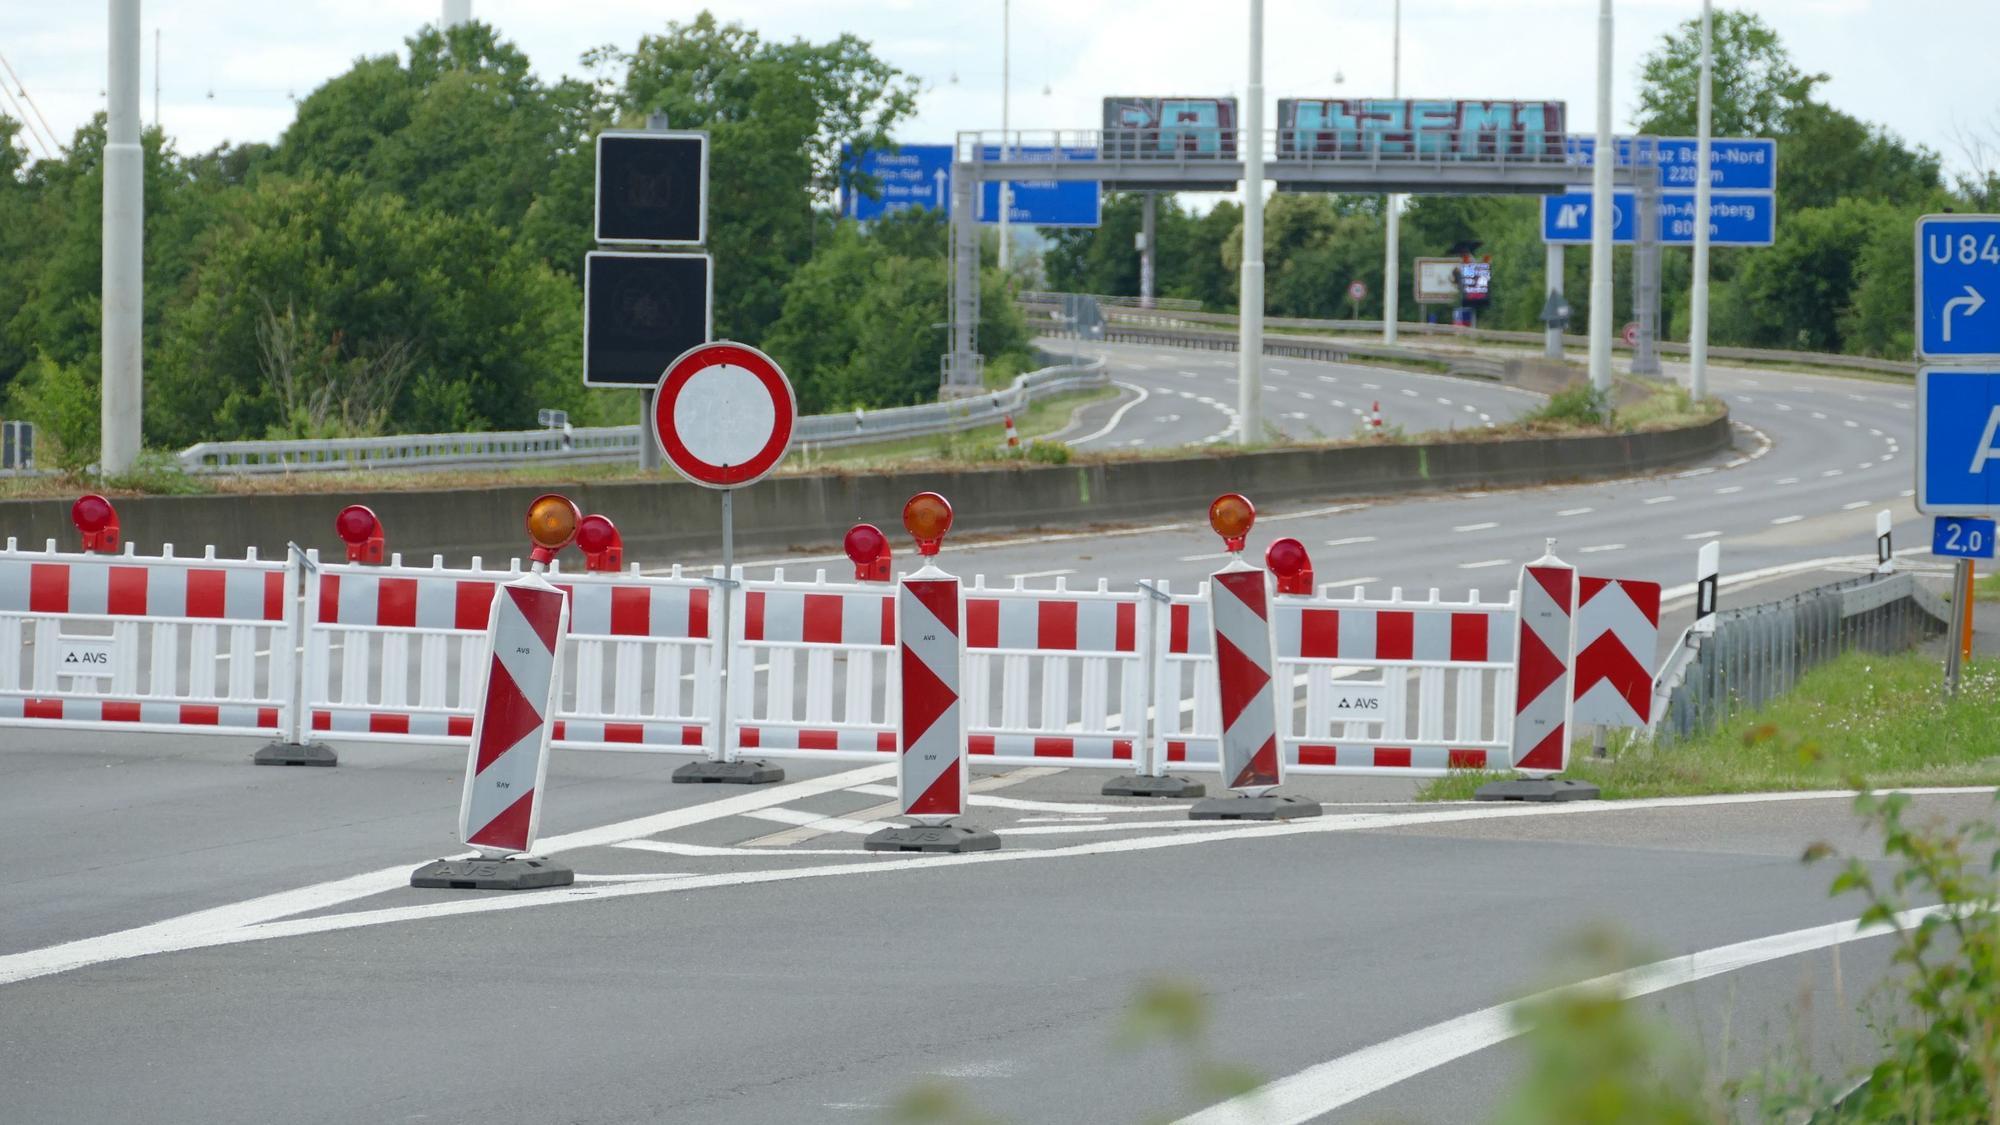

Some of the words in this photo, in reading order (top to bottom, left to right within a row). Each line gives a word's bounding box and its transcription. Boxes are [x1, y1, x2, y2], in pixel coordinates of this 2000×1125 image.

[1679, 147, 1765, 164] Bon-Nord
[1930, 234, 2000, 264] U84
[1945, 523, 1983, 552] 2,0
[82, 652, 107, 664] AVS
[1354, 698, 1378, 709] AVS
[434, 864, 498, 877] AVS
